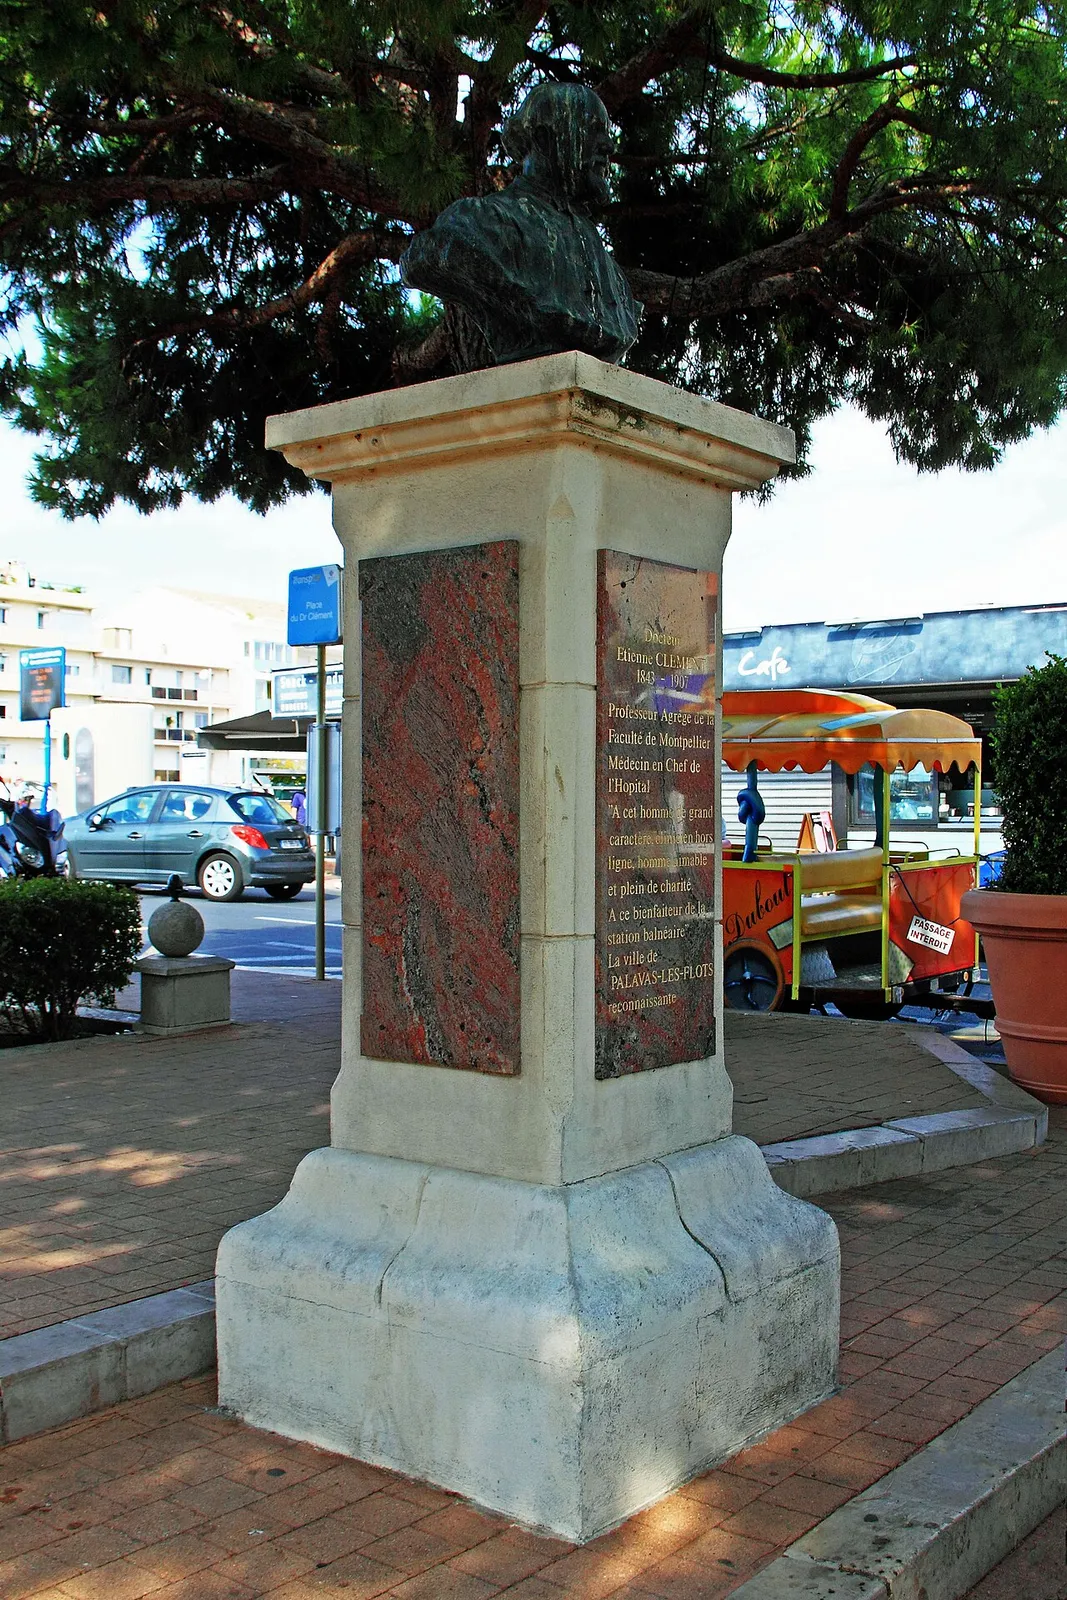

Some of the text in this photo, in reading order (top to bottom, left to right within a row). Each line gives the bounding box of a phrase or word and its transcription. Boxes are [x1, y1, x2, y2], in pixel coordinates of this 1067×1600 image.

[306, 601, 323, 610] Place
[290, 613, 298, 622] du
[300, 612, 307, 621] Dr
[645, 628, 680, 646] Docteur
[617, 646, 706, 673] Etienne CLEMENT
[637, 669, 655, 685] 1843
[670, 674, 689, 688] 1907
[608, 703, 658, 720] Professeur
[694, 711, 704, 725] de
[706, 713, 715, 725] la
[608, 728, 710, 750] Faculté de Montpellier
[608, 755, 701, 773] Médecin en Chef de
[623, 806, 637, 819] cet
[689, 806, 713, 821] grand
[695, 831, 713, 844] hors
[608, 855, 635, 873] ligne,
[608, 883, 617, 896] et
[620, 881, 644, 899] plein
[647, 880, 658, 894] de
[608, 901, 706, 922] A ce bienfaiteur de la
[725, 872, 790, 944] Dubout
[607, 930, 640, 945] station
[914, 918, 951, 939] PASSAGE
[910, 929, 948, 950] INTERDIT
[608, 949, 658, 969] La ville de
[611, 963, 714, 990] PALAVAS-LES-FLOTS
[608, 992, 677, 1014] reconnaissante
